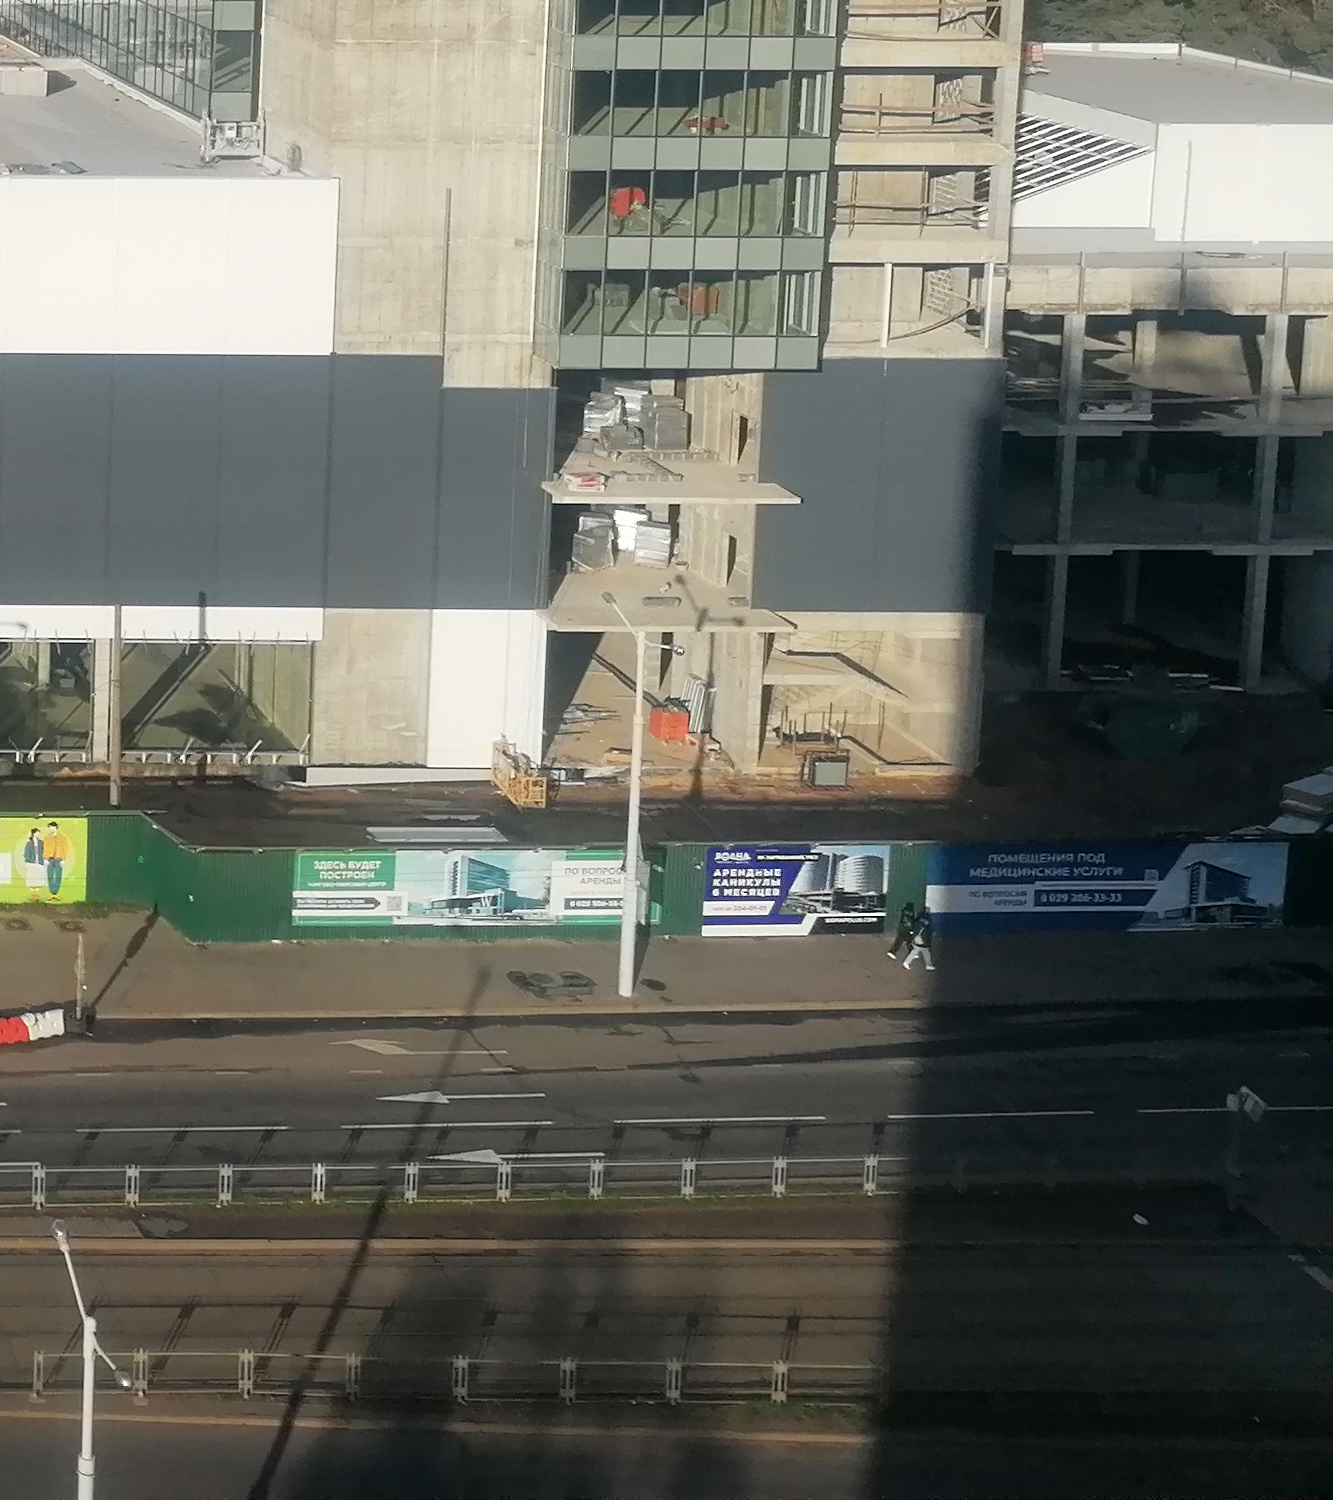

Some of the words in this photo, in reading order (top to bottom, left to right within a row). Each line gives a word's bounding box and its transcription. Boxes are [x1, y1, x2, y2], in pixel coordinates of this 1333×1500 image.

[988, 853, 1074, 864] ПОМЕЩЕНИЯ
[1077, 853, 1106, 864] ПОД
[314, 861, 347, 870] ЗДЕСЬ
[348, 860, 382, 870] БУДЕТ
[320, 871, 375, 879] ПОСТРОЕН
[564, 867, 578, 875] ПО
[713, 868, 782, 877] АРЕНДНЫЕ
[969, 867, 1070, 878] МЕДИЦИНСКИЕ
[1073, 866, 1124, 877] УСЛУГИ
[580, 877, 621, 885] АРЕНДЫ
[712, 878, 781, 887] КАНИКУЛЫ
[712, 888, 720, 896] 6
[723, 888, 781, 897] МЕСЯЦЕВ
